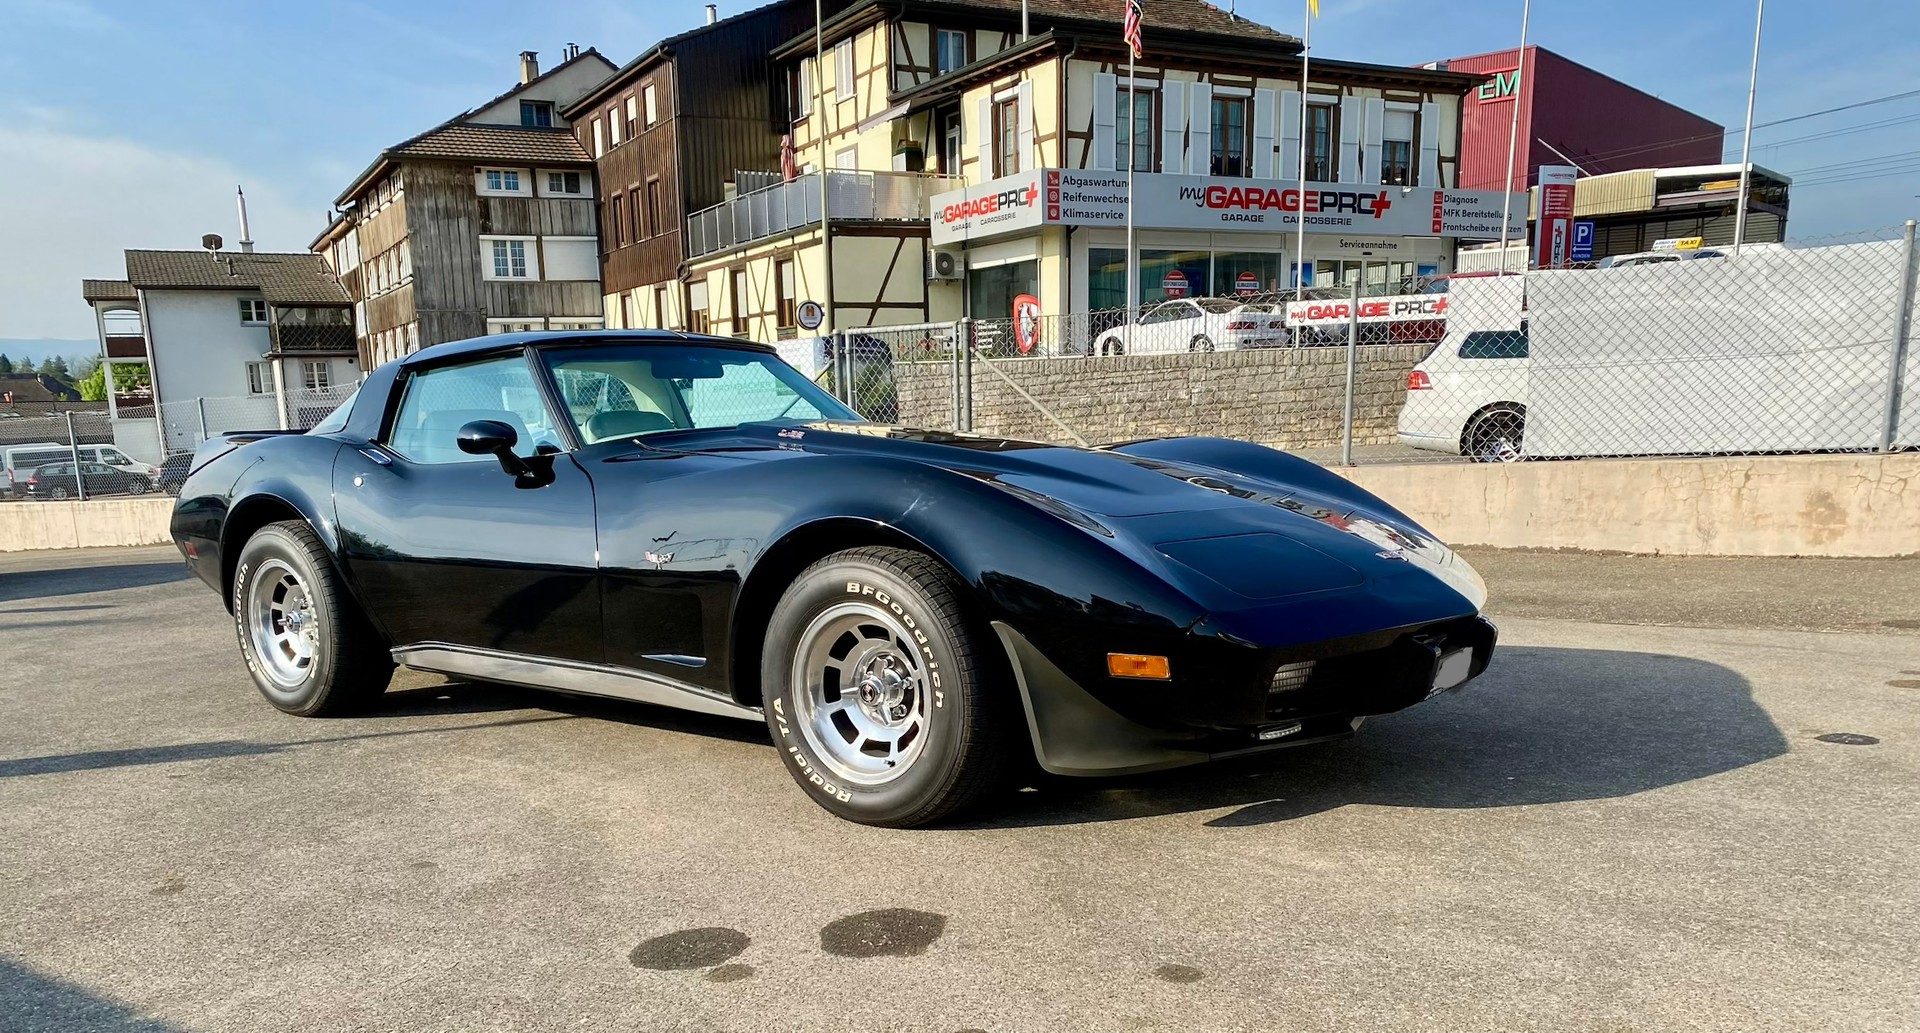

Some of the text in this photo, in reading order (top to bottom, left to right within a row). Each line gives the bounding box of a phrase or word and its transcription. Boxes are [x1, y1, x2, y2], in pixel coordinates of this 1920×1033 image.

[1062, 175, 1130, 188] Abgaswartun
[1062, 191, 1130, 203] Reifenwechse
[1444, 194, 1478, 205] Diagnose
[980, 212, 1016, 225] CARROSSERIE
[1062, 208, 1124, 219] Klimaservice
[1221, 213, 1264, 223] GARAGE
[1443, 208, 1512, 221] MFK Bereitstellug
[951, 222, 972, 232] GARAGE
[1442, 222, 1522, 233] Frontscheibe erszen
[1577, 225, 1588, 242] P
[1339, 238, 1398, 249] Serviceannahme
[236, 562, 257, 673] BFGoodrich
[846, 582, 944, 708] BFGoodrich
[773, 697, 853, 803] Radial T/A
